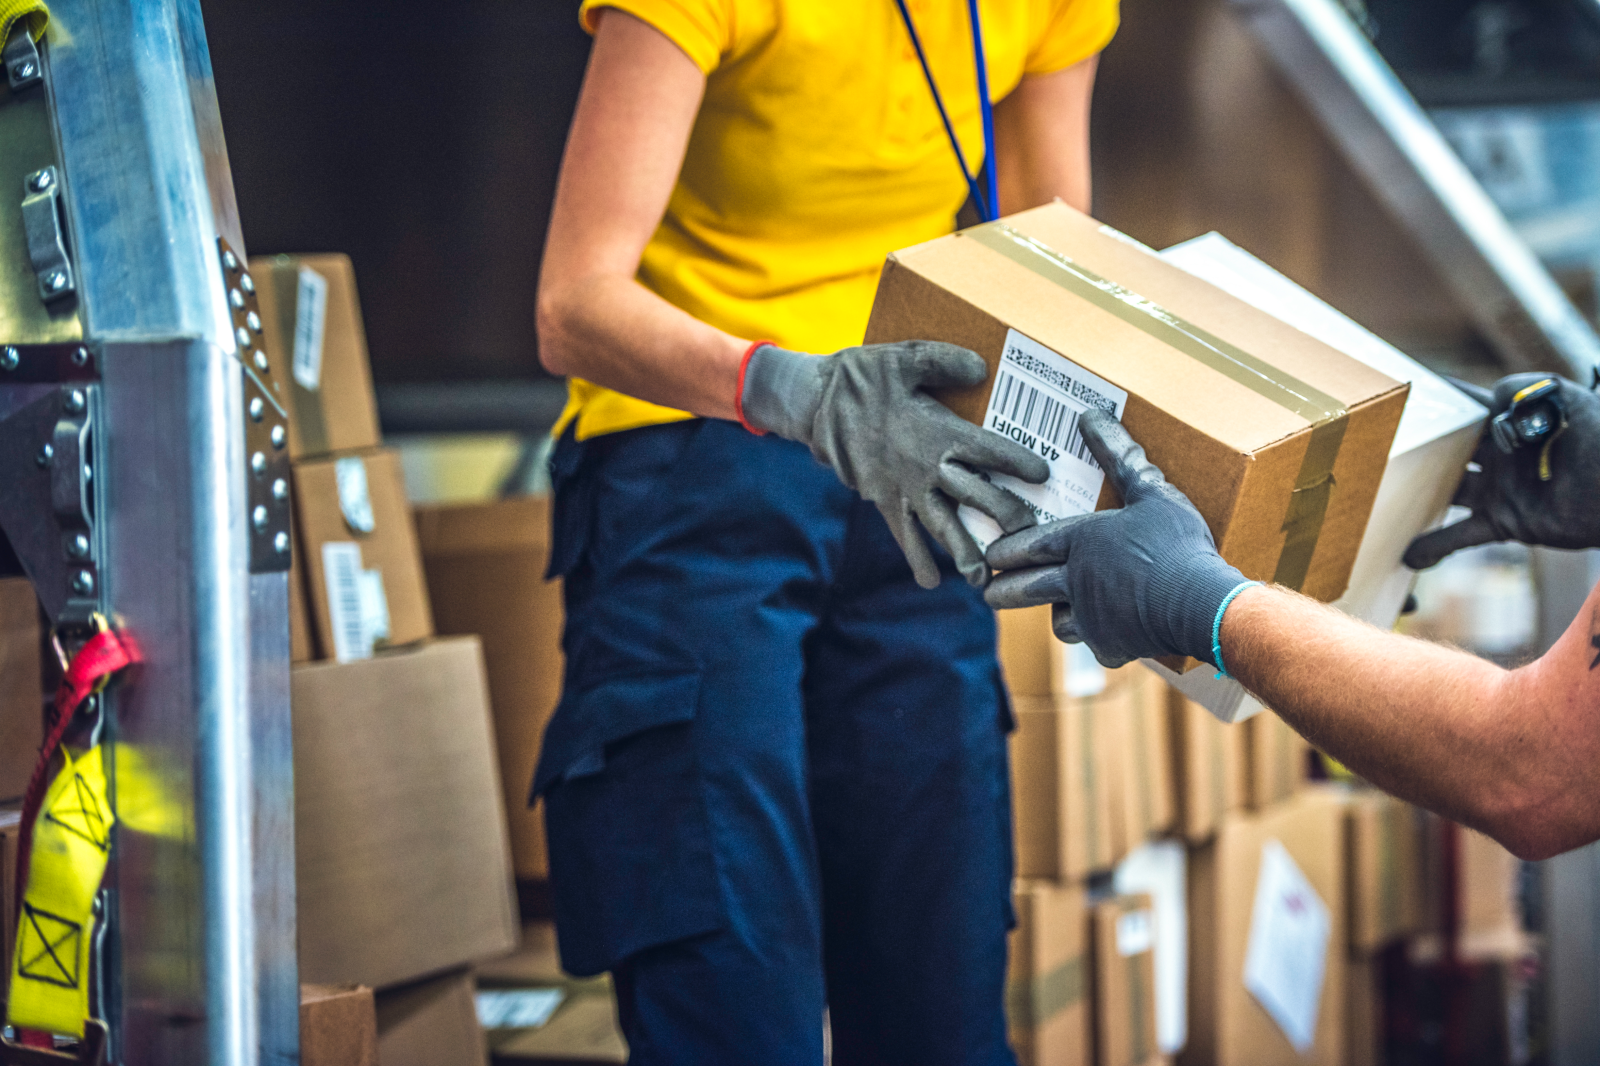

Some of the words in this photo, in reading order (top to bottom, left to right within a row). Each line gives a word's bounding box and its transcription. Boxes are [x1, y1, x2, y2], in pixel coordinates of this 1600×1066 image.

[992, 415, 1037, 450] MDIFI
[1041, 441, 1060, 461] 4A
[1064, 479, 1095, 503] 79273
